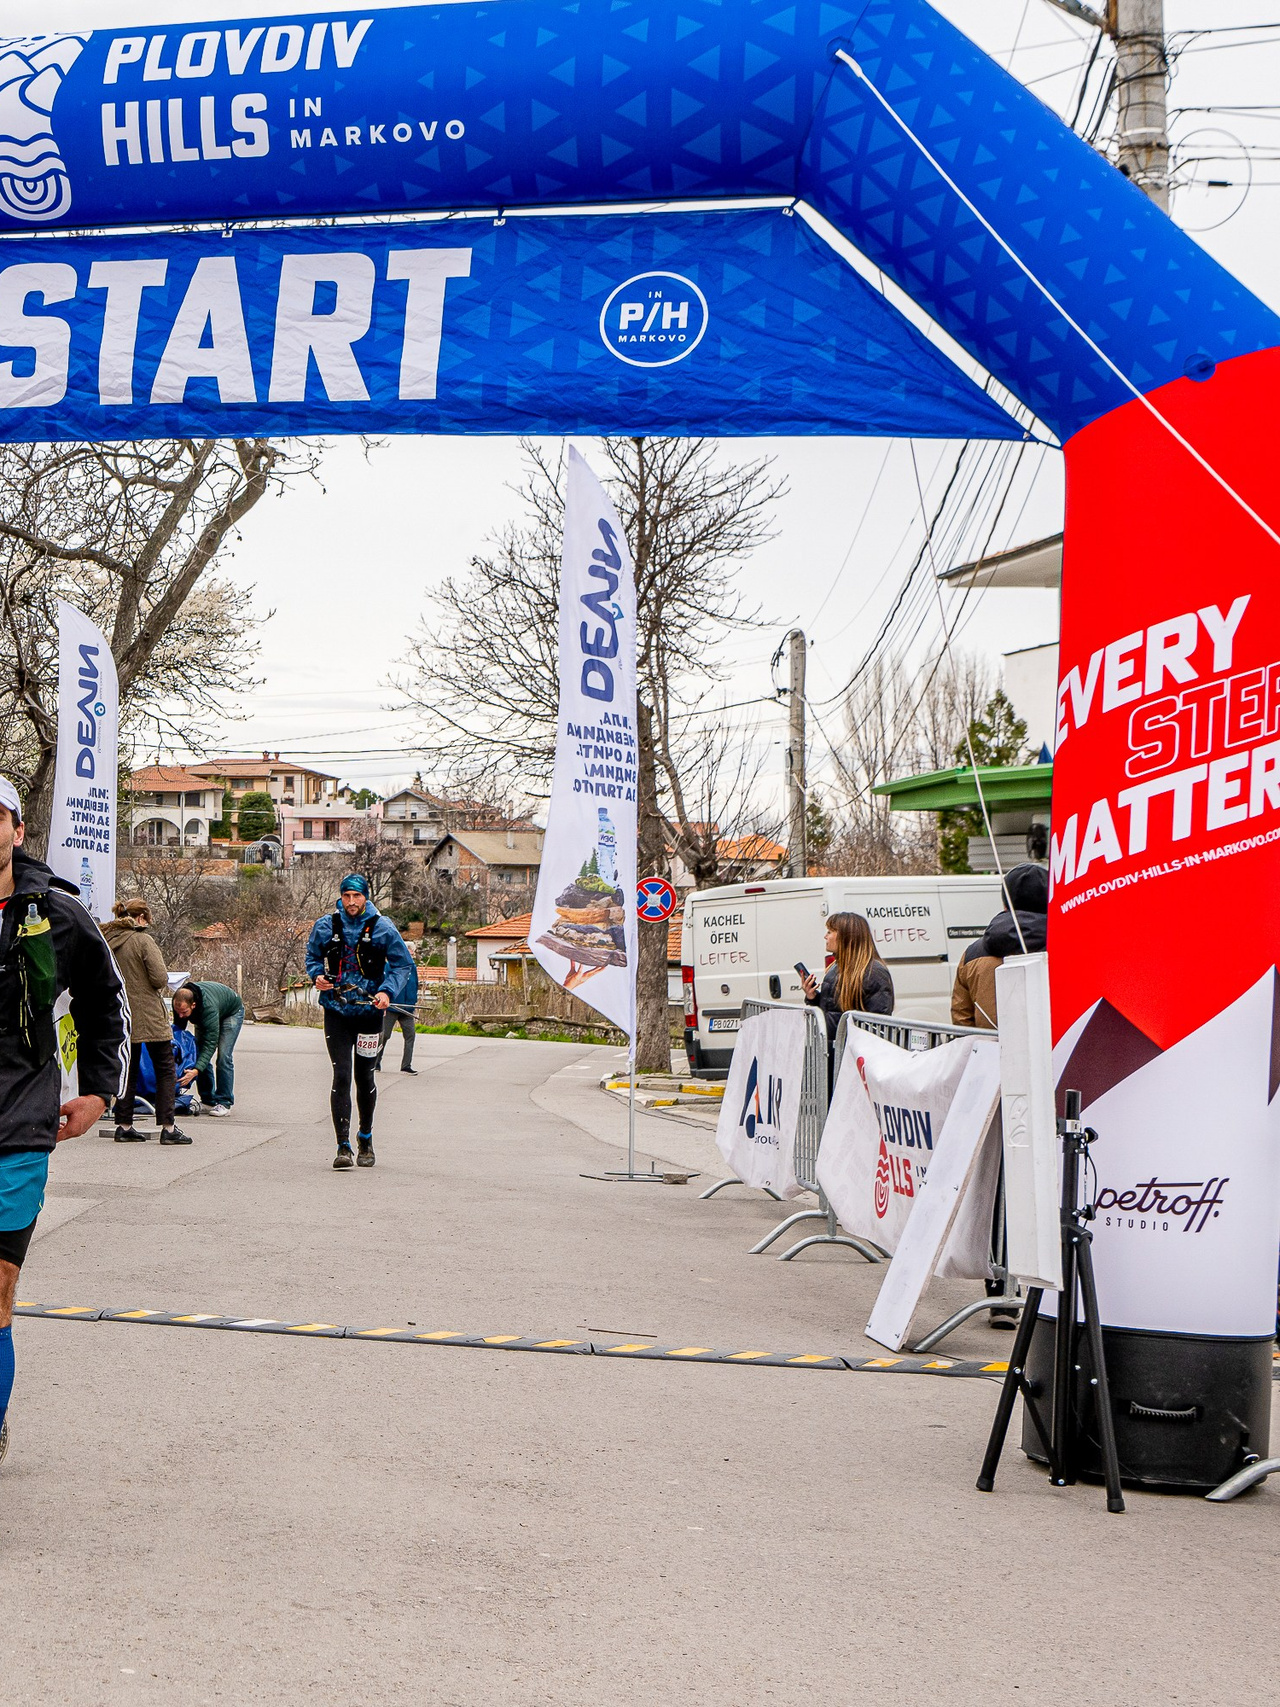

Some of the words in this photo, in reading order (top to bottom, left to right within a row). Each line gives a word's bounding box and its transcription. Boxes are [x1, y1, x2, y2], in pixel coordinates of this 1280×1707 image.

[102, 19, 374, 84] PLOVDIV
[289, 96, 322, 118] IN
[101, 93, 270, 166] HILLS
[290, 119, 466, 149] MARKOVO
[648, 290, 663, 299] IN
[619, 301, 689, 332] P/H
[618, 334, 687, 343] MARKOVO
[1054, 594, 1251, 756] EVERY
[865, 904, 931, 919] KACHELÖFEN
[703, 913, 745, 928] KACHEL
[710, 931, 738, 944] ÖFEN
[873, 928, 931, 943] LEITER
[699, 951, 750, 966] LEITER
[357, 1041, 378, 1049] 4288
[1105, 1216, 1169, 1232] STUDIO
